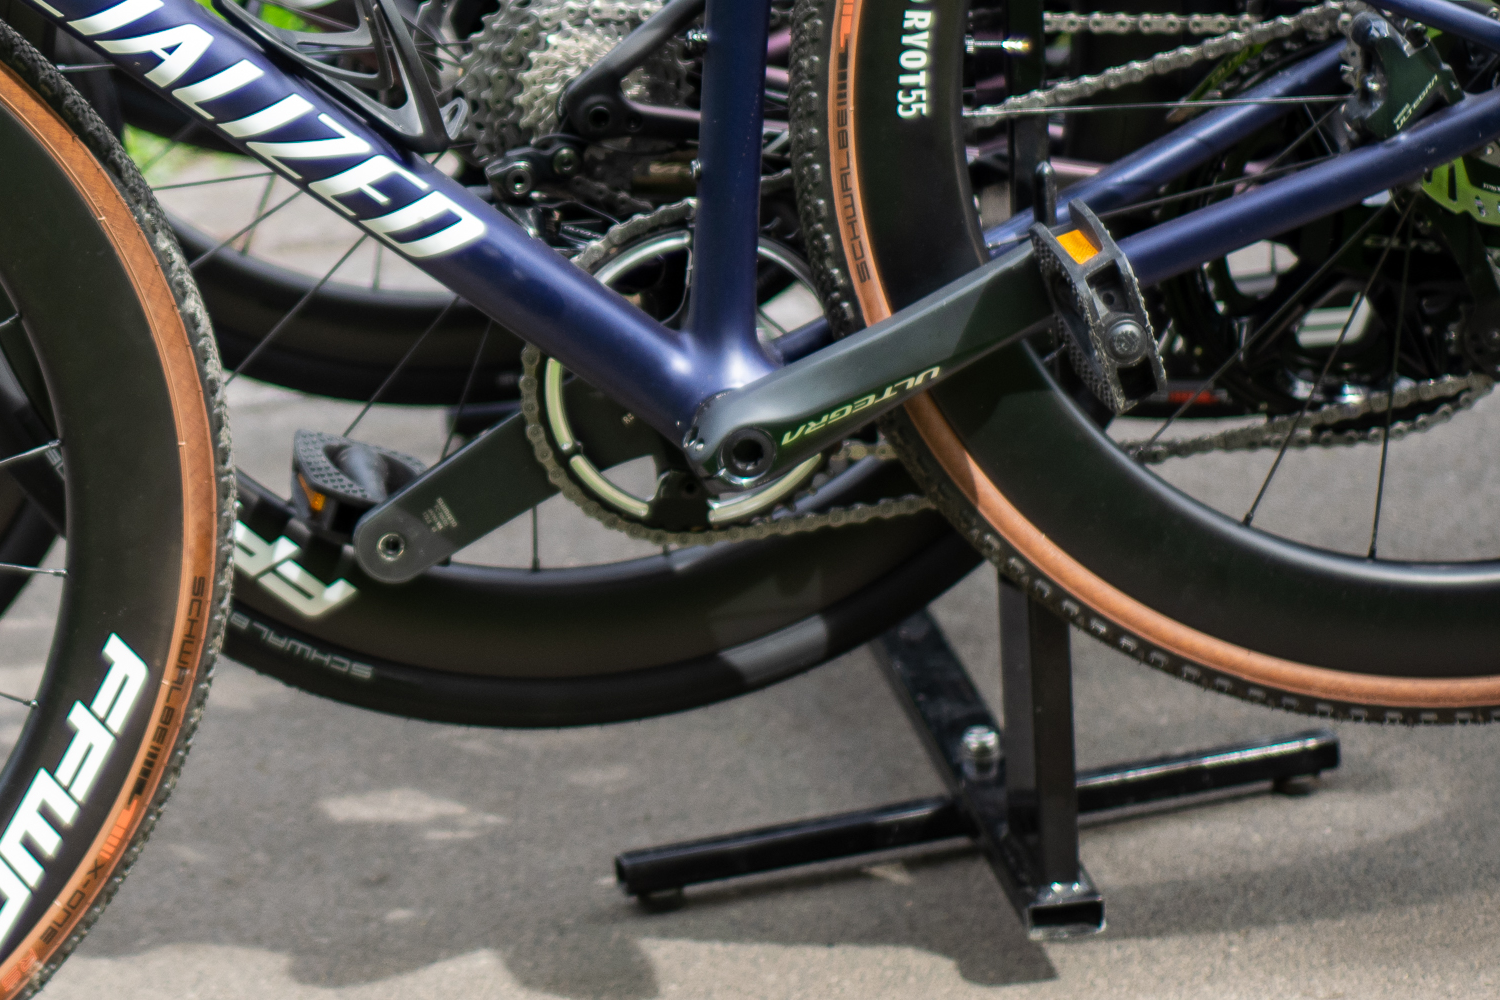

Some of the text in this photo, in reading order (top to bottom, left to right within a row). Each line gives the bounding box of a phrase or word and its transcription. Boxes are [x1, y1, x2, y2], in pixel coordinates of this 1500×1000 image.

[896, 9, 933, 119] RYOT55
[836, 110, 872, 284] SCHWALBE
[781, 365, 941, 446] ULTEGRA
[150, 574, 206, 747] SCHWALBE
[230, 611, 375, 680] SCHWALB
[40, 857, 111, 946] X-ONE
